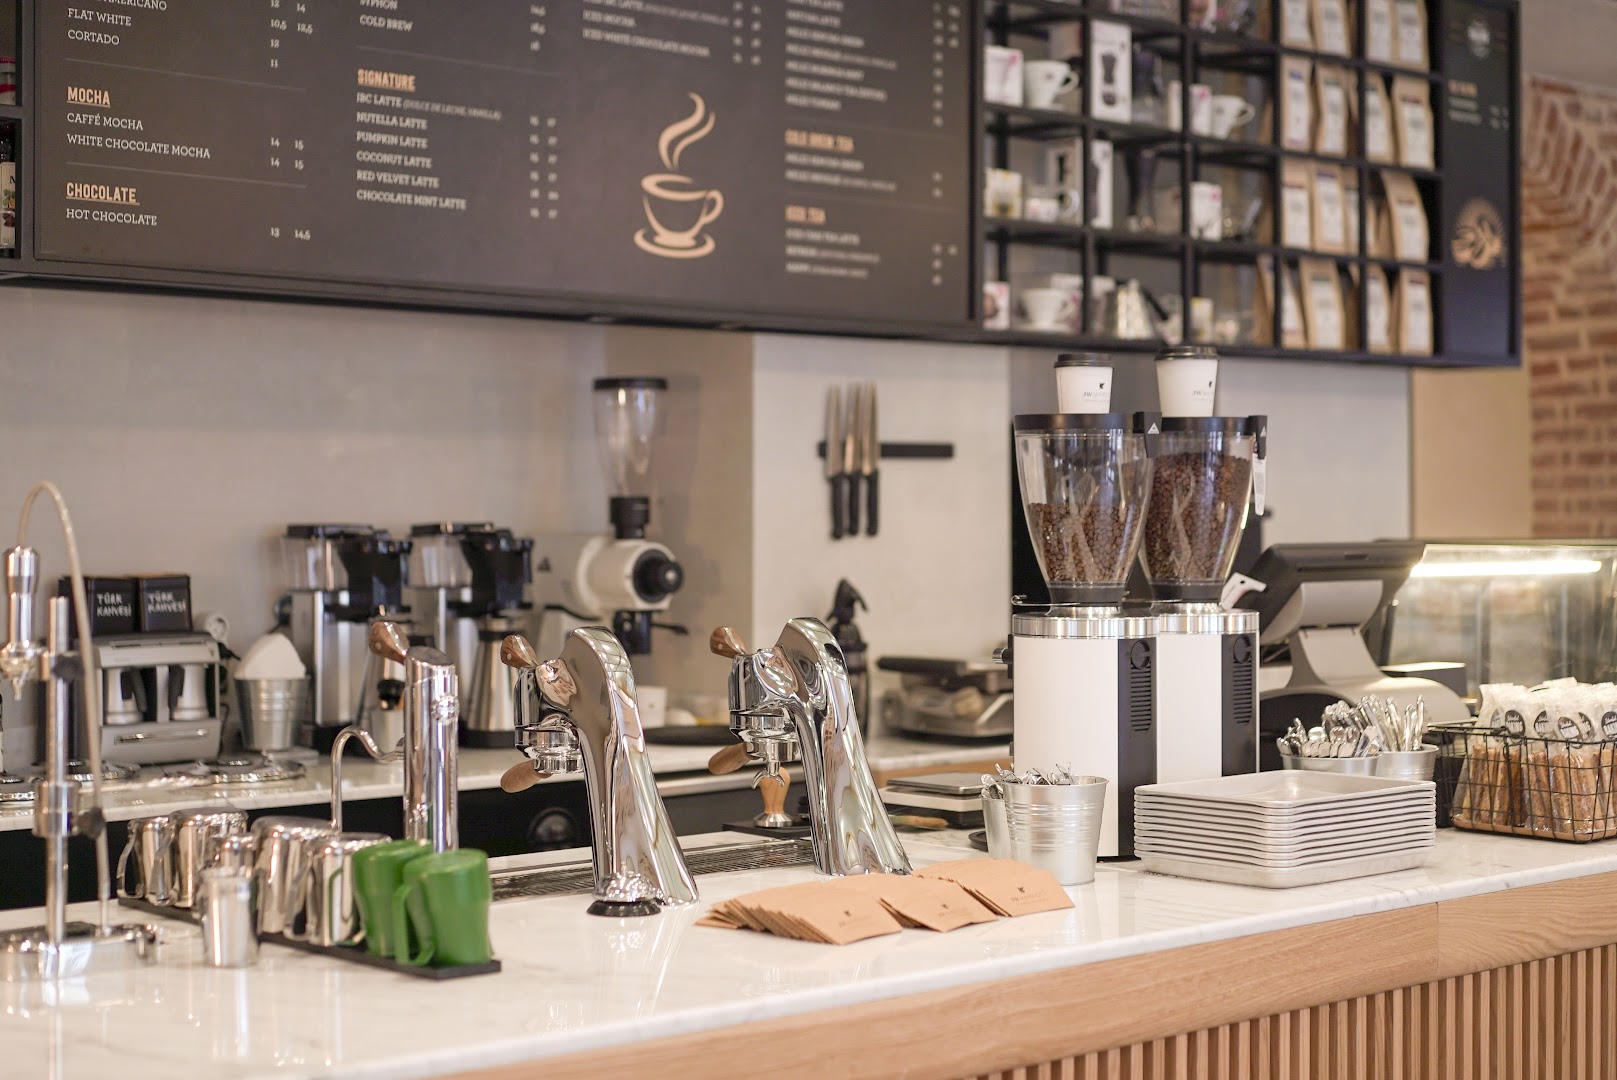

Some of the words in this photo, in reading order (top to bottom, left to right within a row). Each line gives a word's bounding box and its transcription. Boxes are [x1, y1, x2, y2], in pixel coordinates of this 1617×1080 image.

[68, 8, 94, 21] FLAT
[96, 11, 131, 26] WHITE
[359, 14, 386, 28] COLD
[387, 18, 413, 32] BREW
[68, 29, 120, 45] CORTADO
[357, 68, 416, 91] SIGNATURE
[67, 86, 110, 106] MOCHA
[373, 93, 402, 108] LATTE
[67, 112, 101, 127] CAFFÉ
[103, 116, 144, 130] MOCHA
[356, 111, 398, 127] NUTELLA
[399, 116, 428, 130] LATTE
[67, 133, 103, 148] WHITE
[105, 137, 170, 155] CHOCOLATE
[171, 144, 211, 159] MOCHA
[356, 130, 398, 147] PUMPKIN
[399, 135, 428, 150] LATTE
[356, 150, 402, 166] COCONUT
[404, 155, 433, 169] LATTE
[356, 169, 375, 182] RED
[376, 171, 410, 186] VELVET
[411, 176, 440, 189] LATTE
[66, 182, 137, 204] CHOCOLATE
[356, 189, 412, 205] CHOCOLATE
[413, 194, 438, 207] MINT
[439, 197, 467, 210] LATTE
[66, 208, 90, 220] HOT
[92, 211, 158, 227] CHOCOLATE
[97, 592, 123, 605] TÜRK
